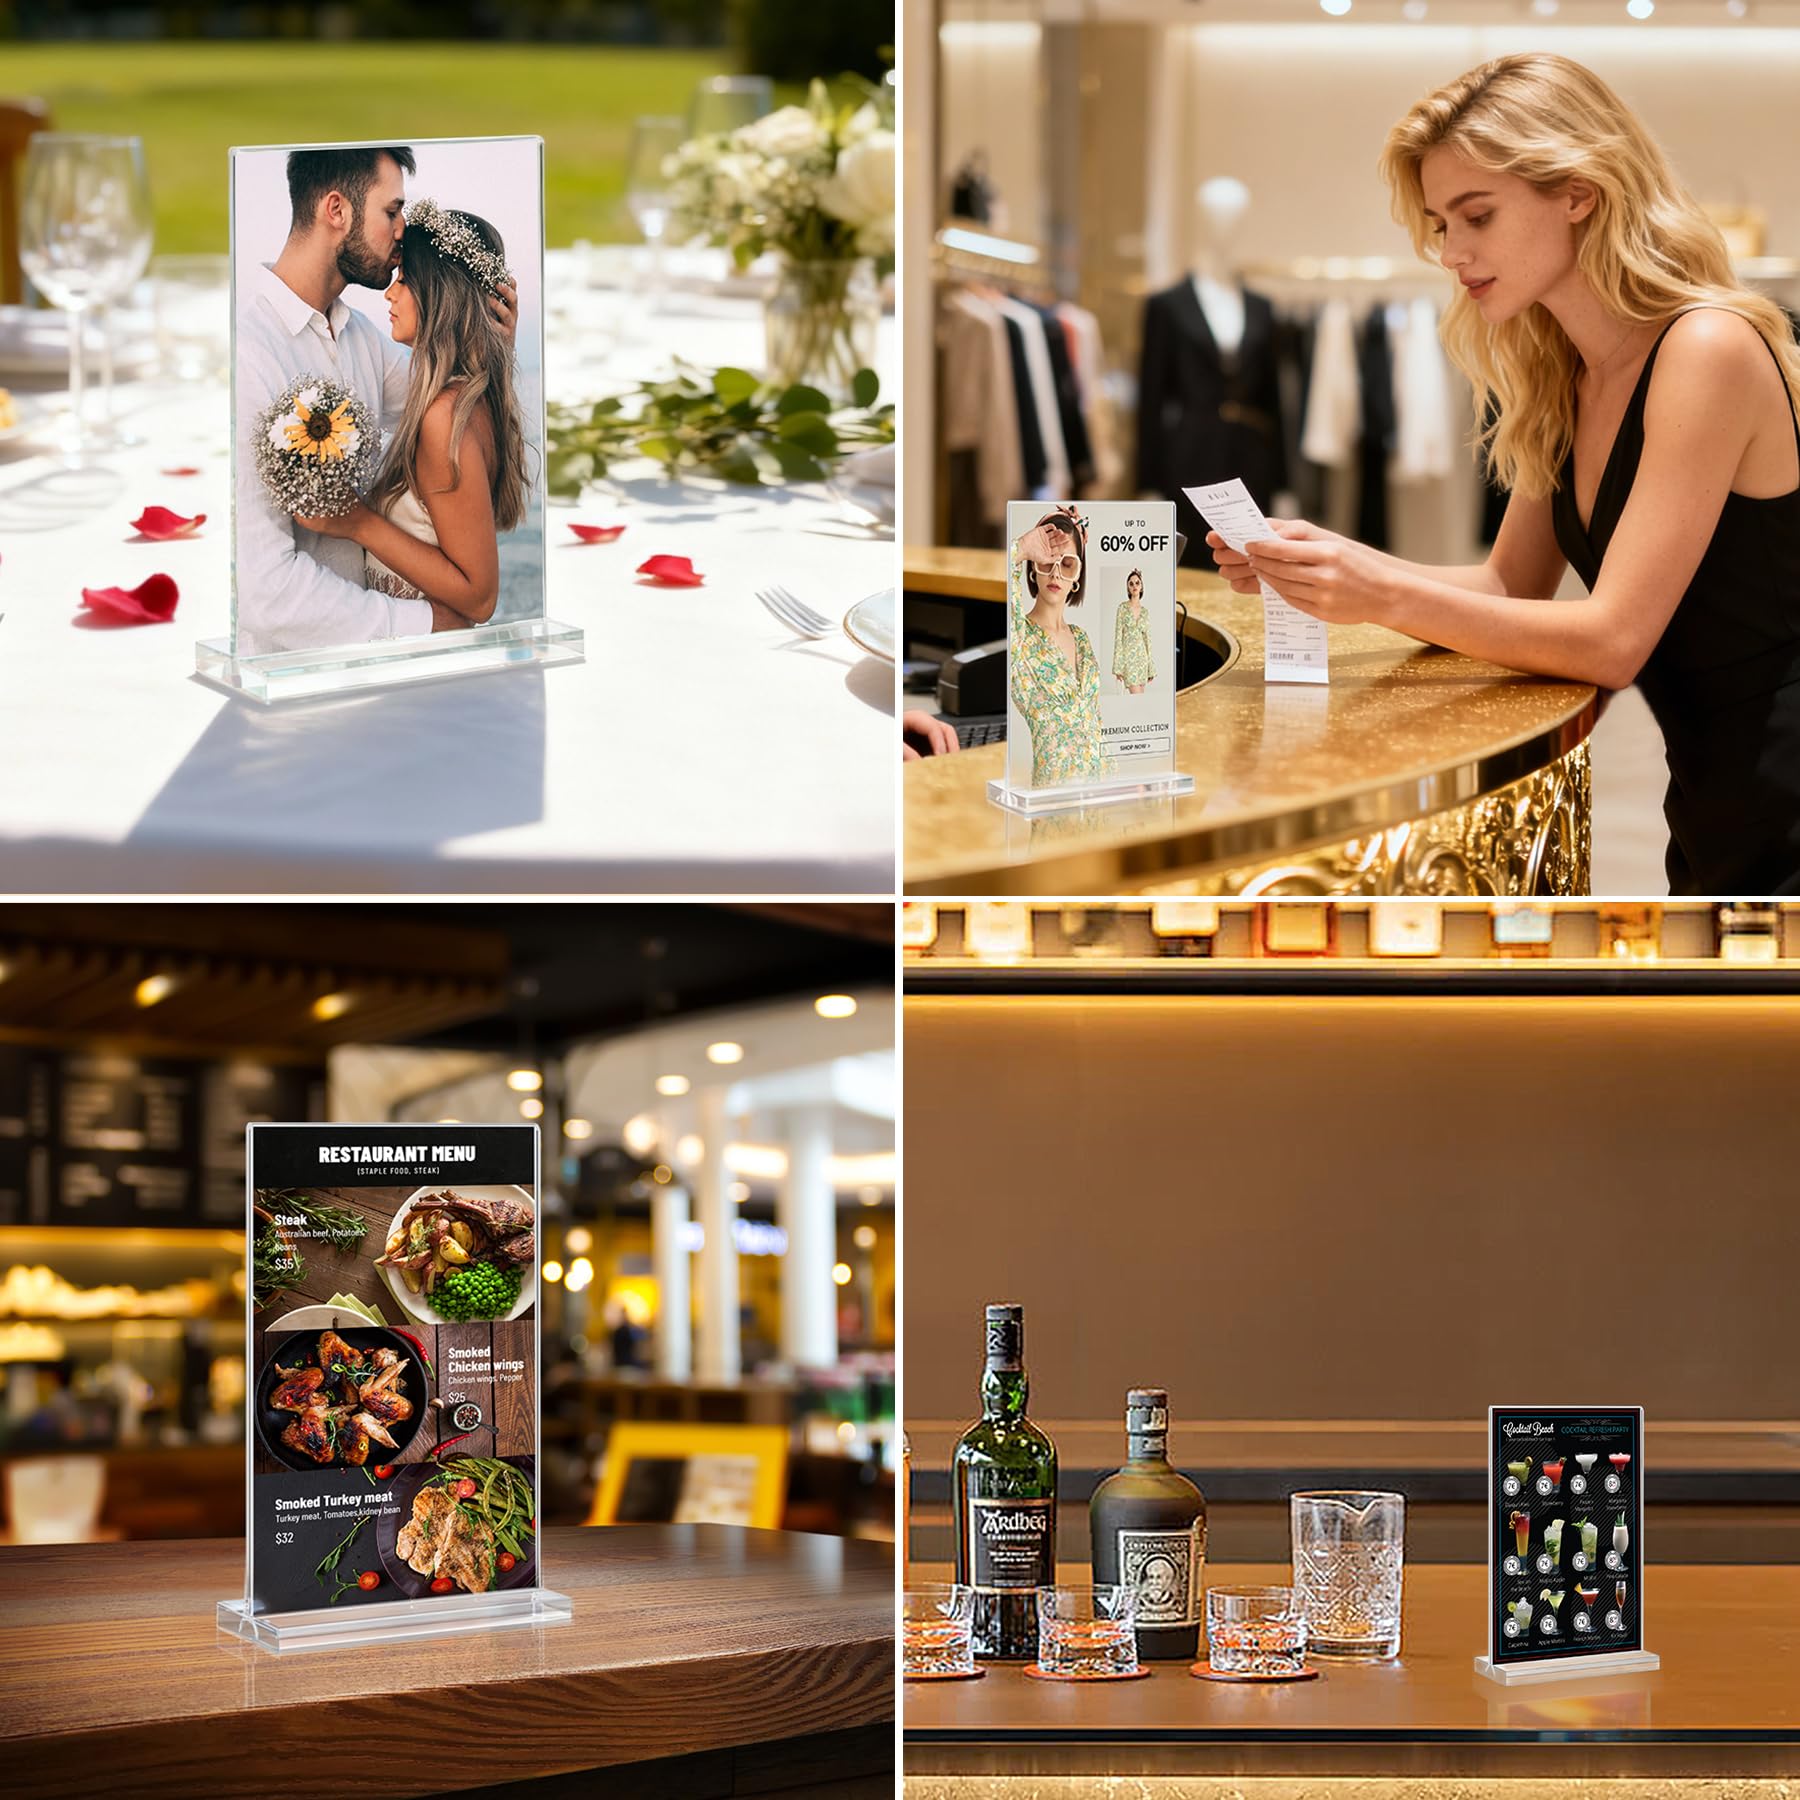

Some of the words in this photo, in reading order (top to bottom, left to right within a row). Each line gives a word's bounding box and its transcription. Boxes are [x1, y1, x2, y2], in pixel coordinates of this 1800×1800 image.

[1124, 519, 1135, 528] UP
[1136, 519, 1146, 528] TO
[1100, 534, 1135, 552] 60%
[1138, 534, 1169, 552] OFF
[1100, 726, 1130, 736] PREMIUM
[1131, 723, 1169, 734] COLLECTION
[319, 1146, 428, 1163] RESTAURANT
[431, 1145, 476, 1162] MENU
[274, 1213, 308, 1226] Steak
[274, 1229, 312, 1239] Australian
[274, 1257, 294, 1271] $35
[448, 1345, 491, 1359] Smoked
[448, 1360, 491, 1373] Chicken
[493, 1359, 524, 1372] wings
[448, 1376, 476, 1385] Chicken
[499, 1373, 523, 1383] Pepper
[448, 1391, 466, 1404] $25
[1502, 1421, 1532, 1438] Cocktail
[275, 1496, 321, 1511] Smoked
[322, 1494, 362, 1507] Turkey
[364, 1491, 393, 1503] meat
[275, 1513, 300, 1523] Turkey
[383, 1506, 401, 1514] bean
[275, 1532, 294, 1545] $32
